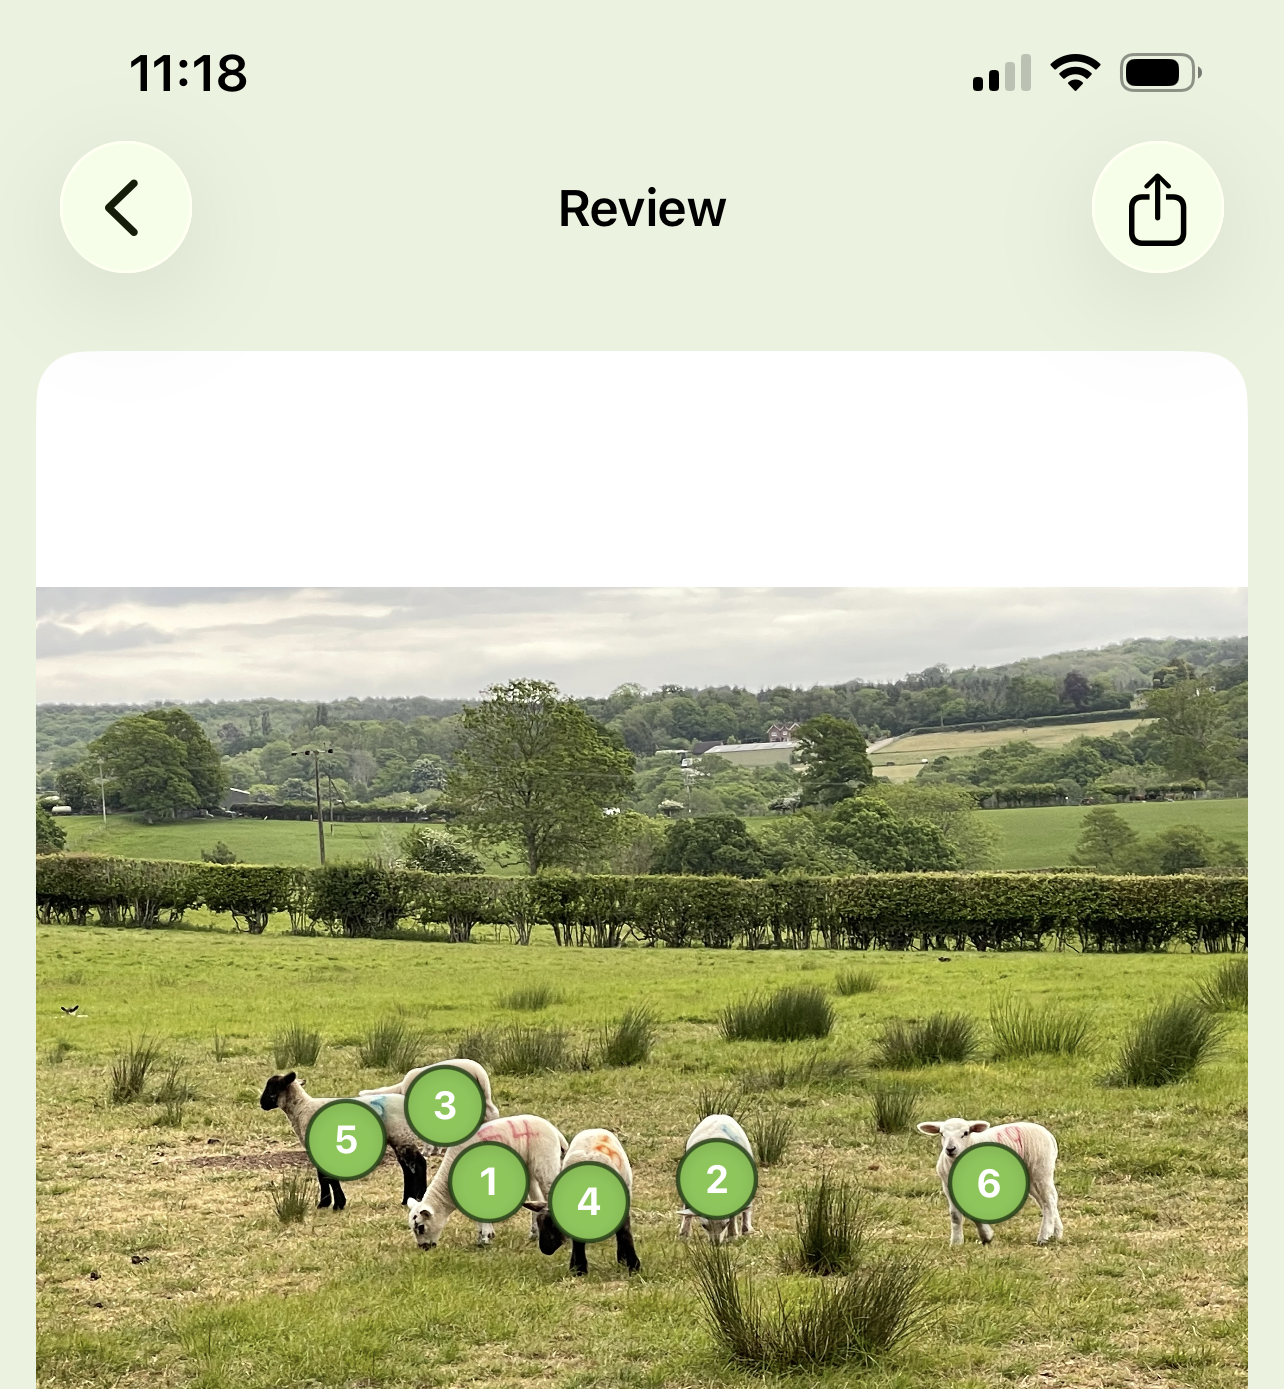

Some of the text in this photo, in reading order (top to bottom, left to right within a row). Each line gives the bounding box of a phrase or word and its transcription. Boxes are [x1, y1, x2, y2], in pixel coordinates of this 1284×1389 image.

[130, 53, 247, 93] 11:18
[560, 186, 727, 228] Review
[434, 1090, 457, 1121] 3
[336, 1124, 358, 1155] 5
[480, 1166, 495, 1196] 1
[706, 1164, 728, 1194] 2
[977, 1168, 1001, 1199] 6
[577, 1186, 601, 1216] 4
